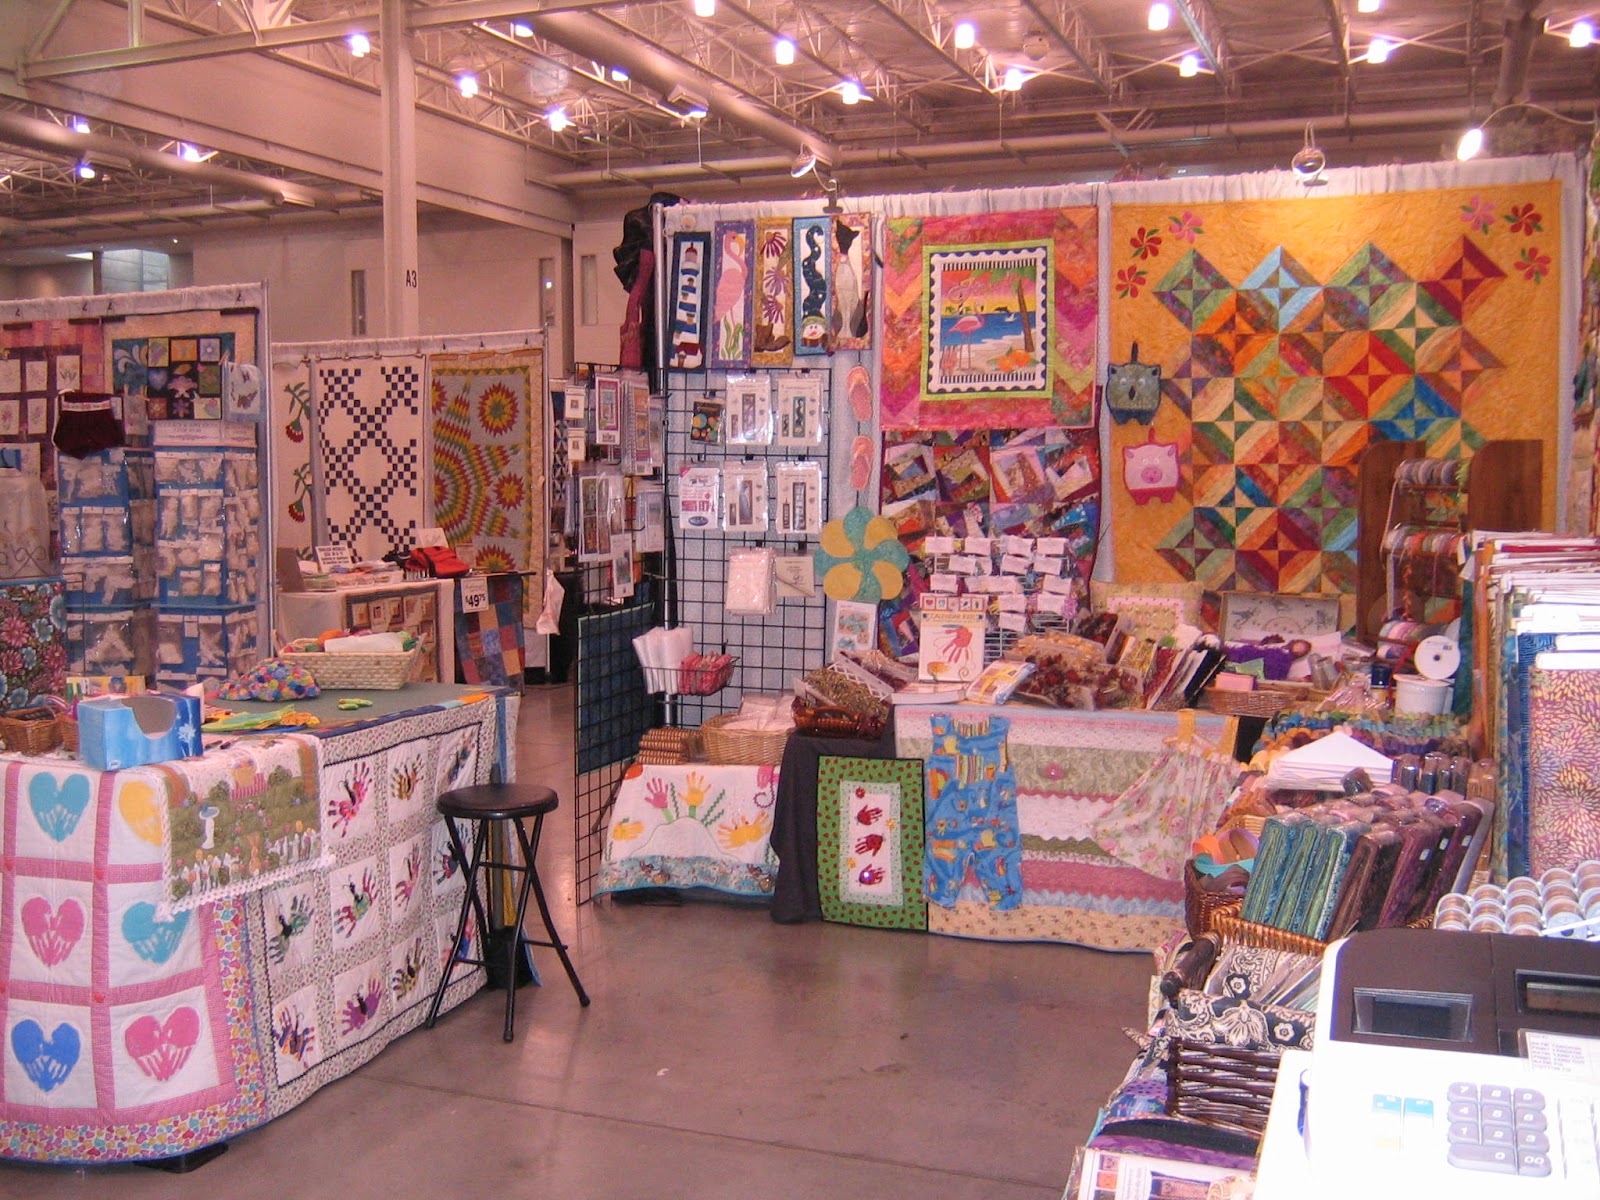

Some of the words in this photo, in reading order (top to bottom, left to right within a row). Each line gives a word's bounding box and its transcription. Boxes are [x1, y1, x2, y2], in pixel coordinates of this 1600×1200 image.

[406, 269, 417, 288] A3
[1460, 1085, 1469, 1093] 7
[1491, 1089, 1502, 1098] 8
[1522, 1093, 1533, 1101] 9
[1459, 1106, 1469, 1114] 4
[1492, 1110, 1503, 1118] 5
[1523, 1113, 1534, 1122] 6
[1461, 1126, 1468, 1135] 1
[1493, 1131, 1504, 1139] 2
[1525, 1134, 1536, 1143] 3
[1494, 1152, 1506, 1160] 0
[1524, 1155, 1545, 1165] 00
